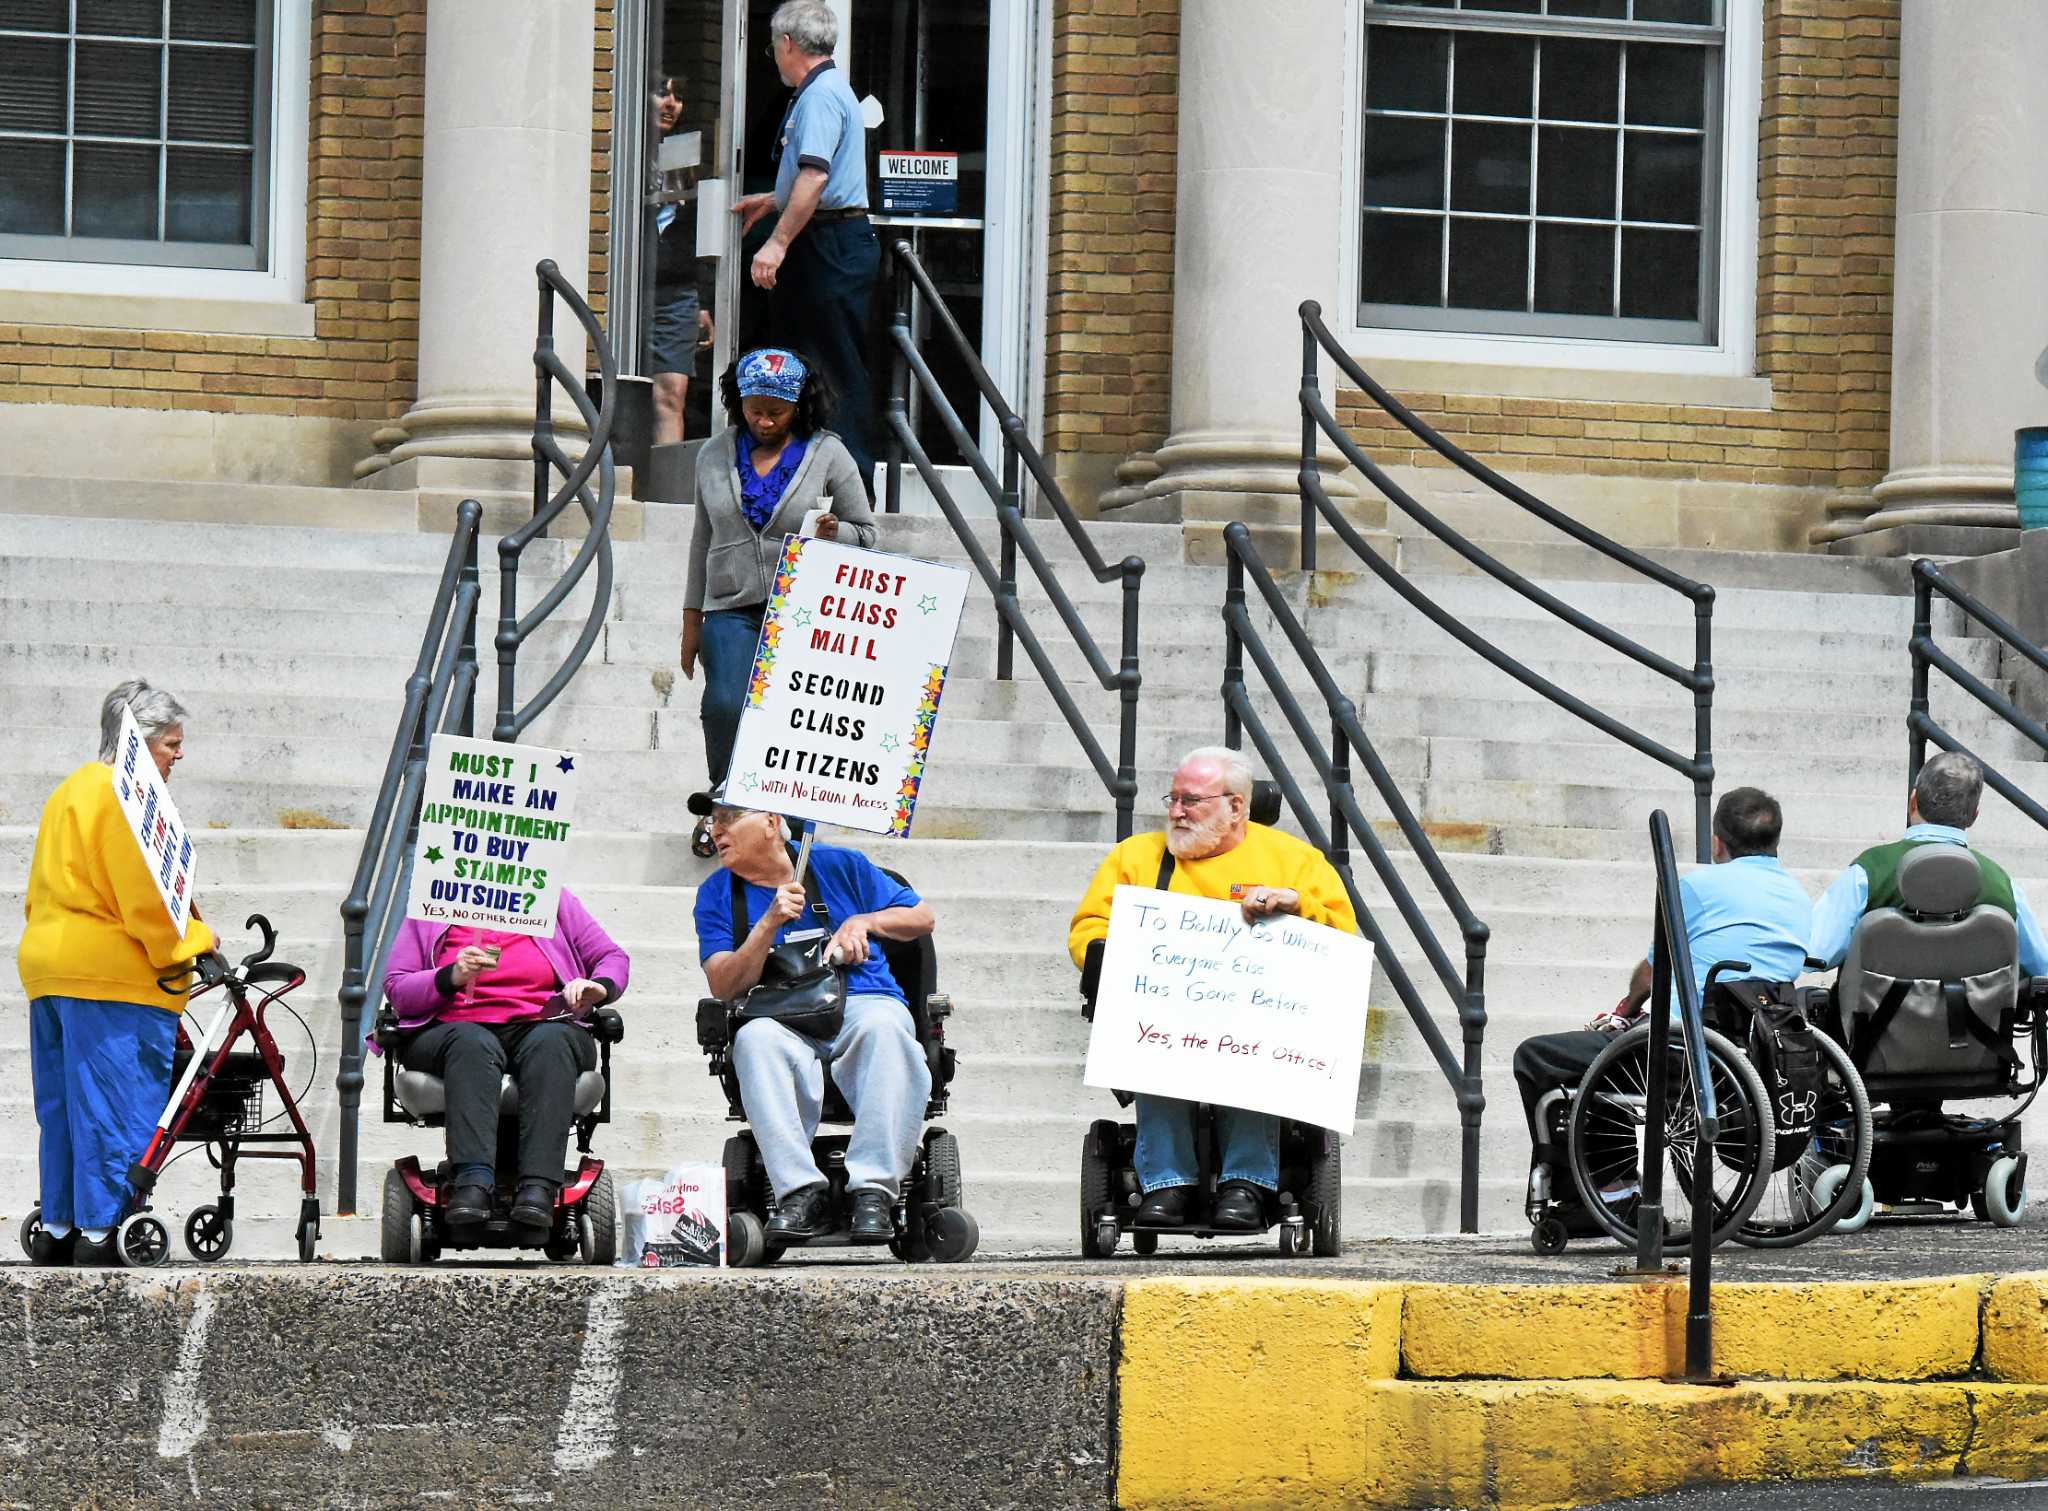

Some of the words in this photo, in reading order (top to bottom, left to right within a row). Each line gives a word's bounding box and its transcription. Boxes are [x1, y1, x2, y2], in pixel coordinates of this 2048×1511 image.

[888, 158, 949, 176] WELCOME
[835, 564, 907, 596] FIRST
[820, 595, 898, 629] CLASS
[810, 628, 878, 661] MAIL
[788, 670, 885, 706] SECOND
[790, 708, 865, 741] CLASS
[124, 728, 139, 781] YEARS
[449, 752, 515, 778] MUST
[528, 763, 537, 783] I
[764, 746, 880, 786] CITIZENS
[134, 780, 145, 806] IS
[453, 779, 515, 805] MAKE
[525, 788, 558, 811] AN
[761, 779, 788, 794] WITH
[141, 782, 159, 849] ENOUGH
[422, 802, 570, 842] APPOINTMENT
[153, 809, 167, 857] TIME
[453, 830, 478, 853] TO
[486, 836, 530, 862] BUY
[160, 822, 178, 890] COMPLY
[454, 857, 548, 890] STAMPS
[170, 895, 181, 921] TO
[430, 879, 536, 915] OUTSIDE?
[452, 909, 469, 919] NO
[471, 911, 507, 924] OTHER
[1133, 903, 1167, 931] To
[1179, 910, 1242, 952] Boldly
[1249, 921, 1274, 942] Go
[1151, 944, 1224, 976] Everyone
[1232, 955, 1265, 975] Else
[1134, 974, 1170, 997] Has
[1186, 981, 1237, 1002] Gone
[1250, 988, 1311, 1015] Before
[1137, 1020, 1173, 1048] Yes,
[1180, 1033, 1209, 1050] the
[1217, 1034, 1263, 1056] Post
